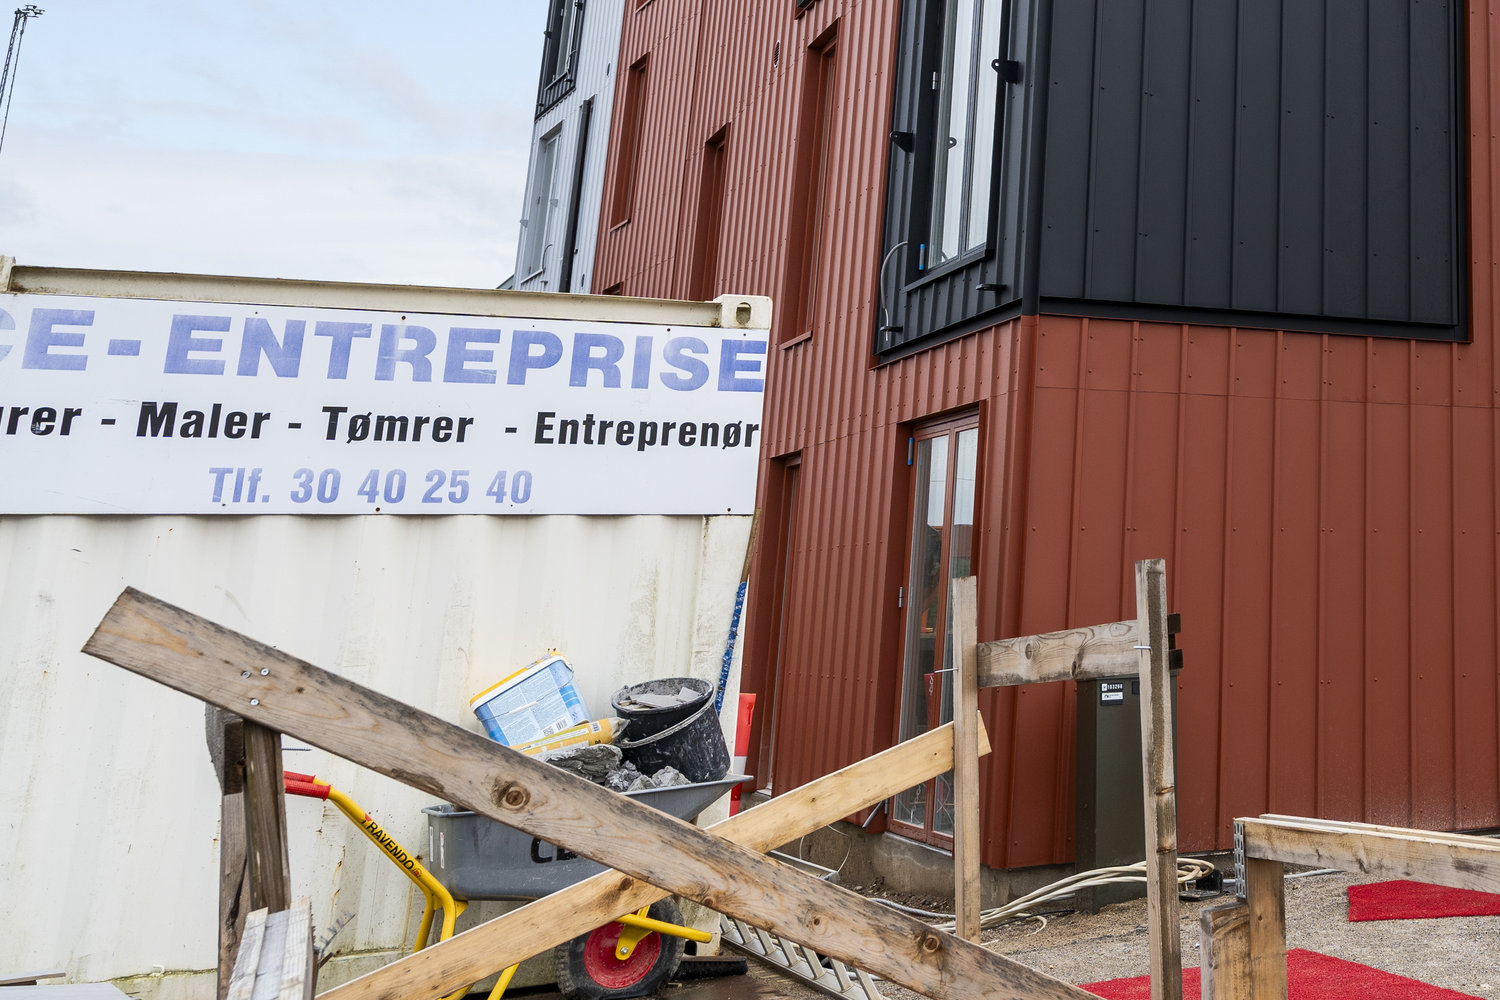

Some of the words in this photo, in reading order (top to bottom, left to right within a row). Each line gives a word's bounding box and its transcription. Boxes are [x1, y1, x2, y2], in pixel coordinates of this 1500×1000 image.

[0, 405, 83, 436] rer
[136, 401, 271, 439] Maler
[322, 405, 474, 444] Tømrer
[534, 411, 760, 451] Entreprenør
[208, 467, 271, 504] Tlf.
[290, 468, 342, 504] 30
[357, 469, 407, 504] 40
[421, 469, 471, 504] 25
[486, 470, 533, 505] 40
